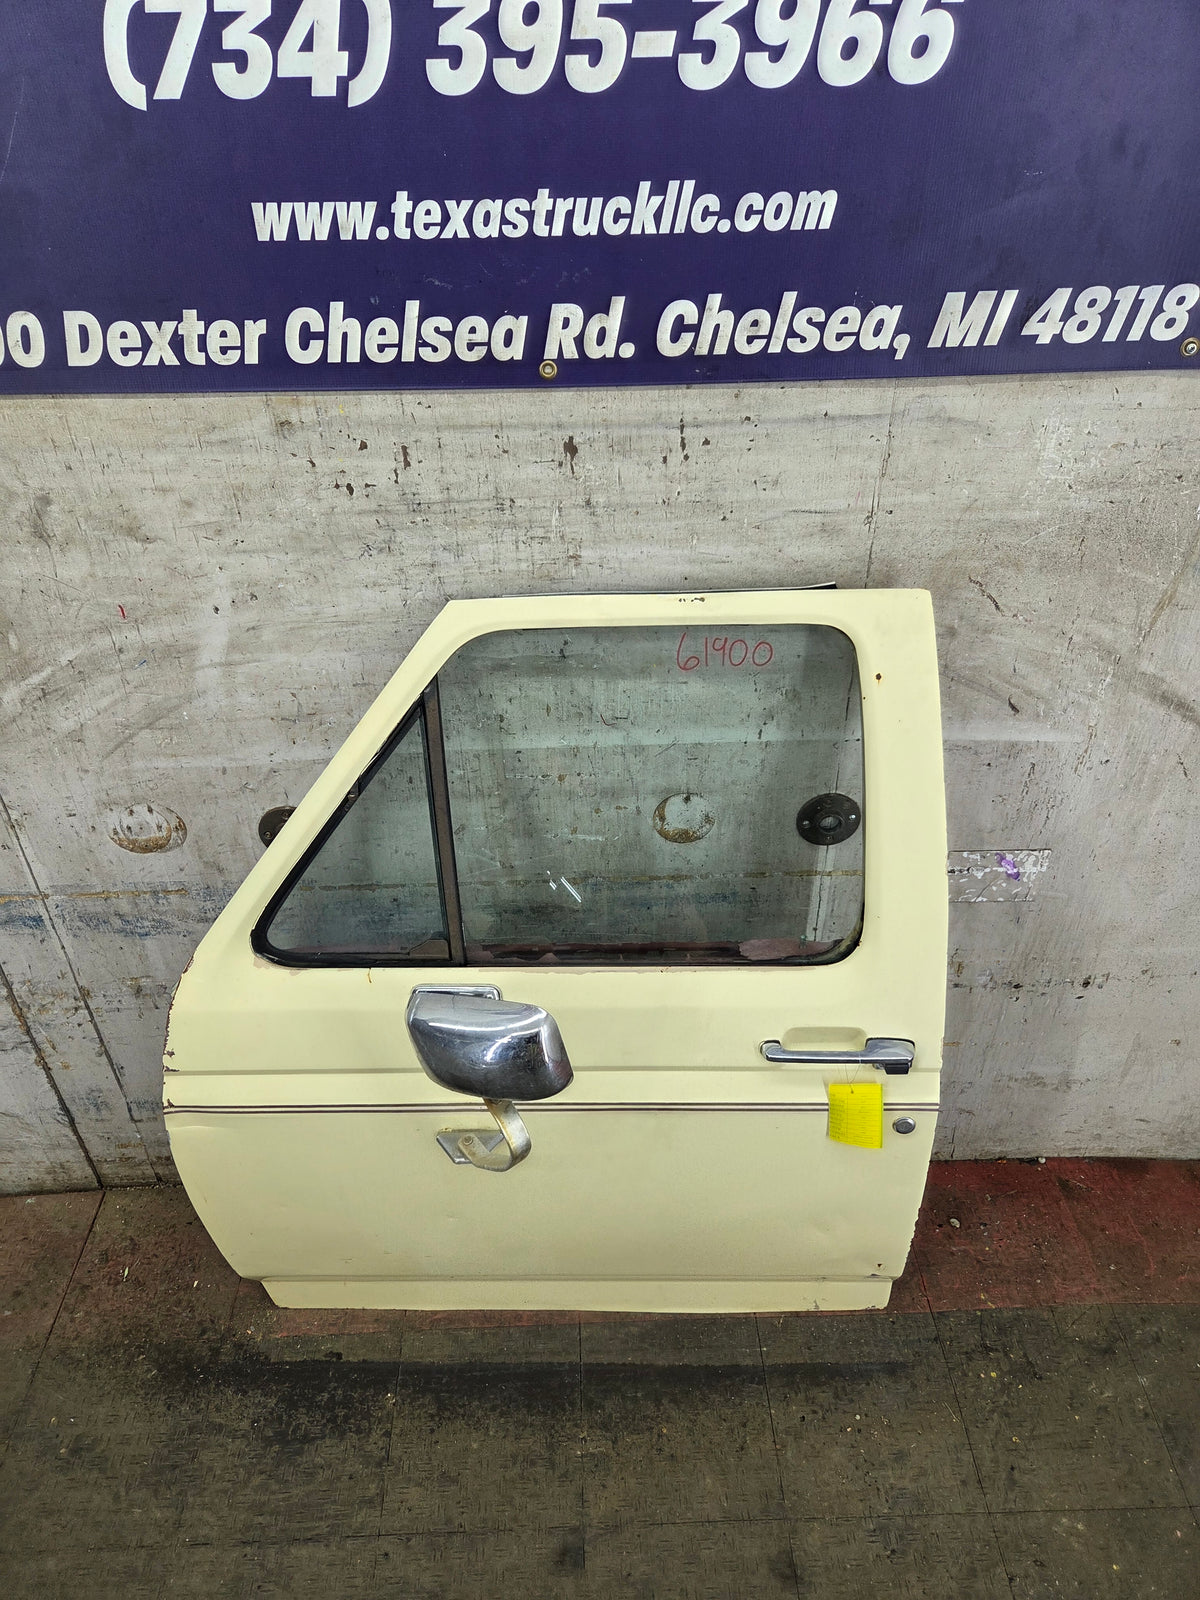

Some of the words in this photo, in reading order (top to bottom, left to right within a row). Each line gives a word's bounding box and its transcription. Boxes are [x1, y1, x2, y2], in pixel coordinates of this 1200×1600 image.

[103, 0, 392, 111] (734)
[426, 0, 965, 97] 395-3966
[251, 180, 838, 242] www.texastruckllc.com
[0, 311, 46, 368] 0
[63, 309, 267, 367] Dexter
[285, 300, 529, 365] Chelsea
[544, 296, 636, 361] Rd.
[656, 291, 911, 360] Chelsea,
[927, 289, 1019, 349] MI
[1020, 283, 1200, 345] 48118
[676, 631, 774, 671] 61900
